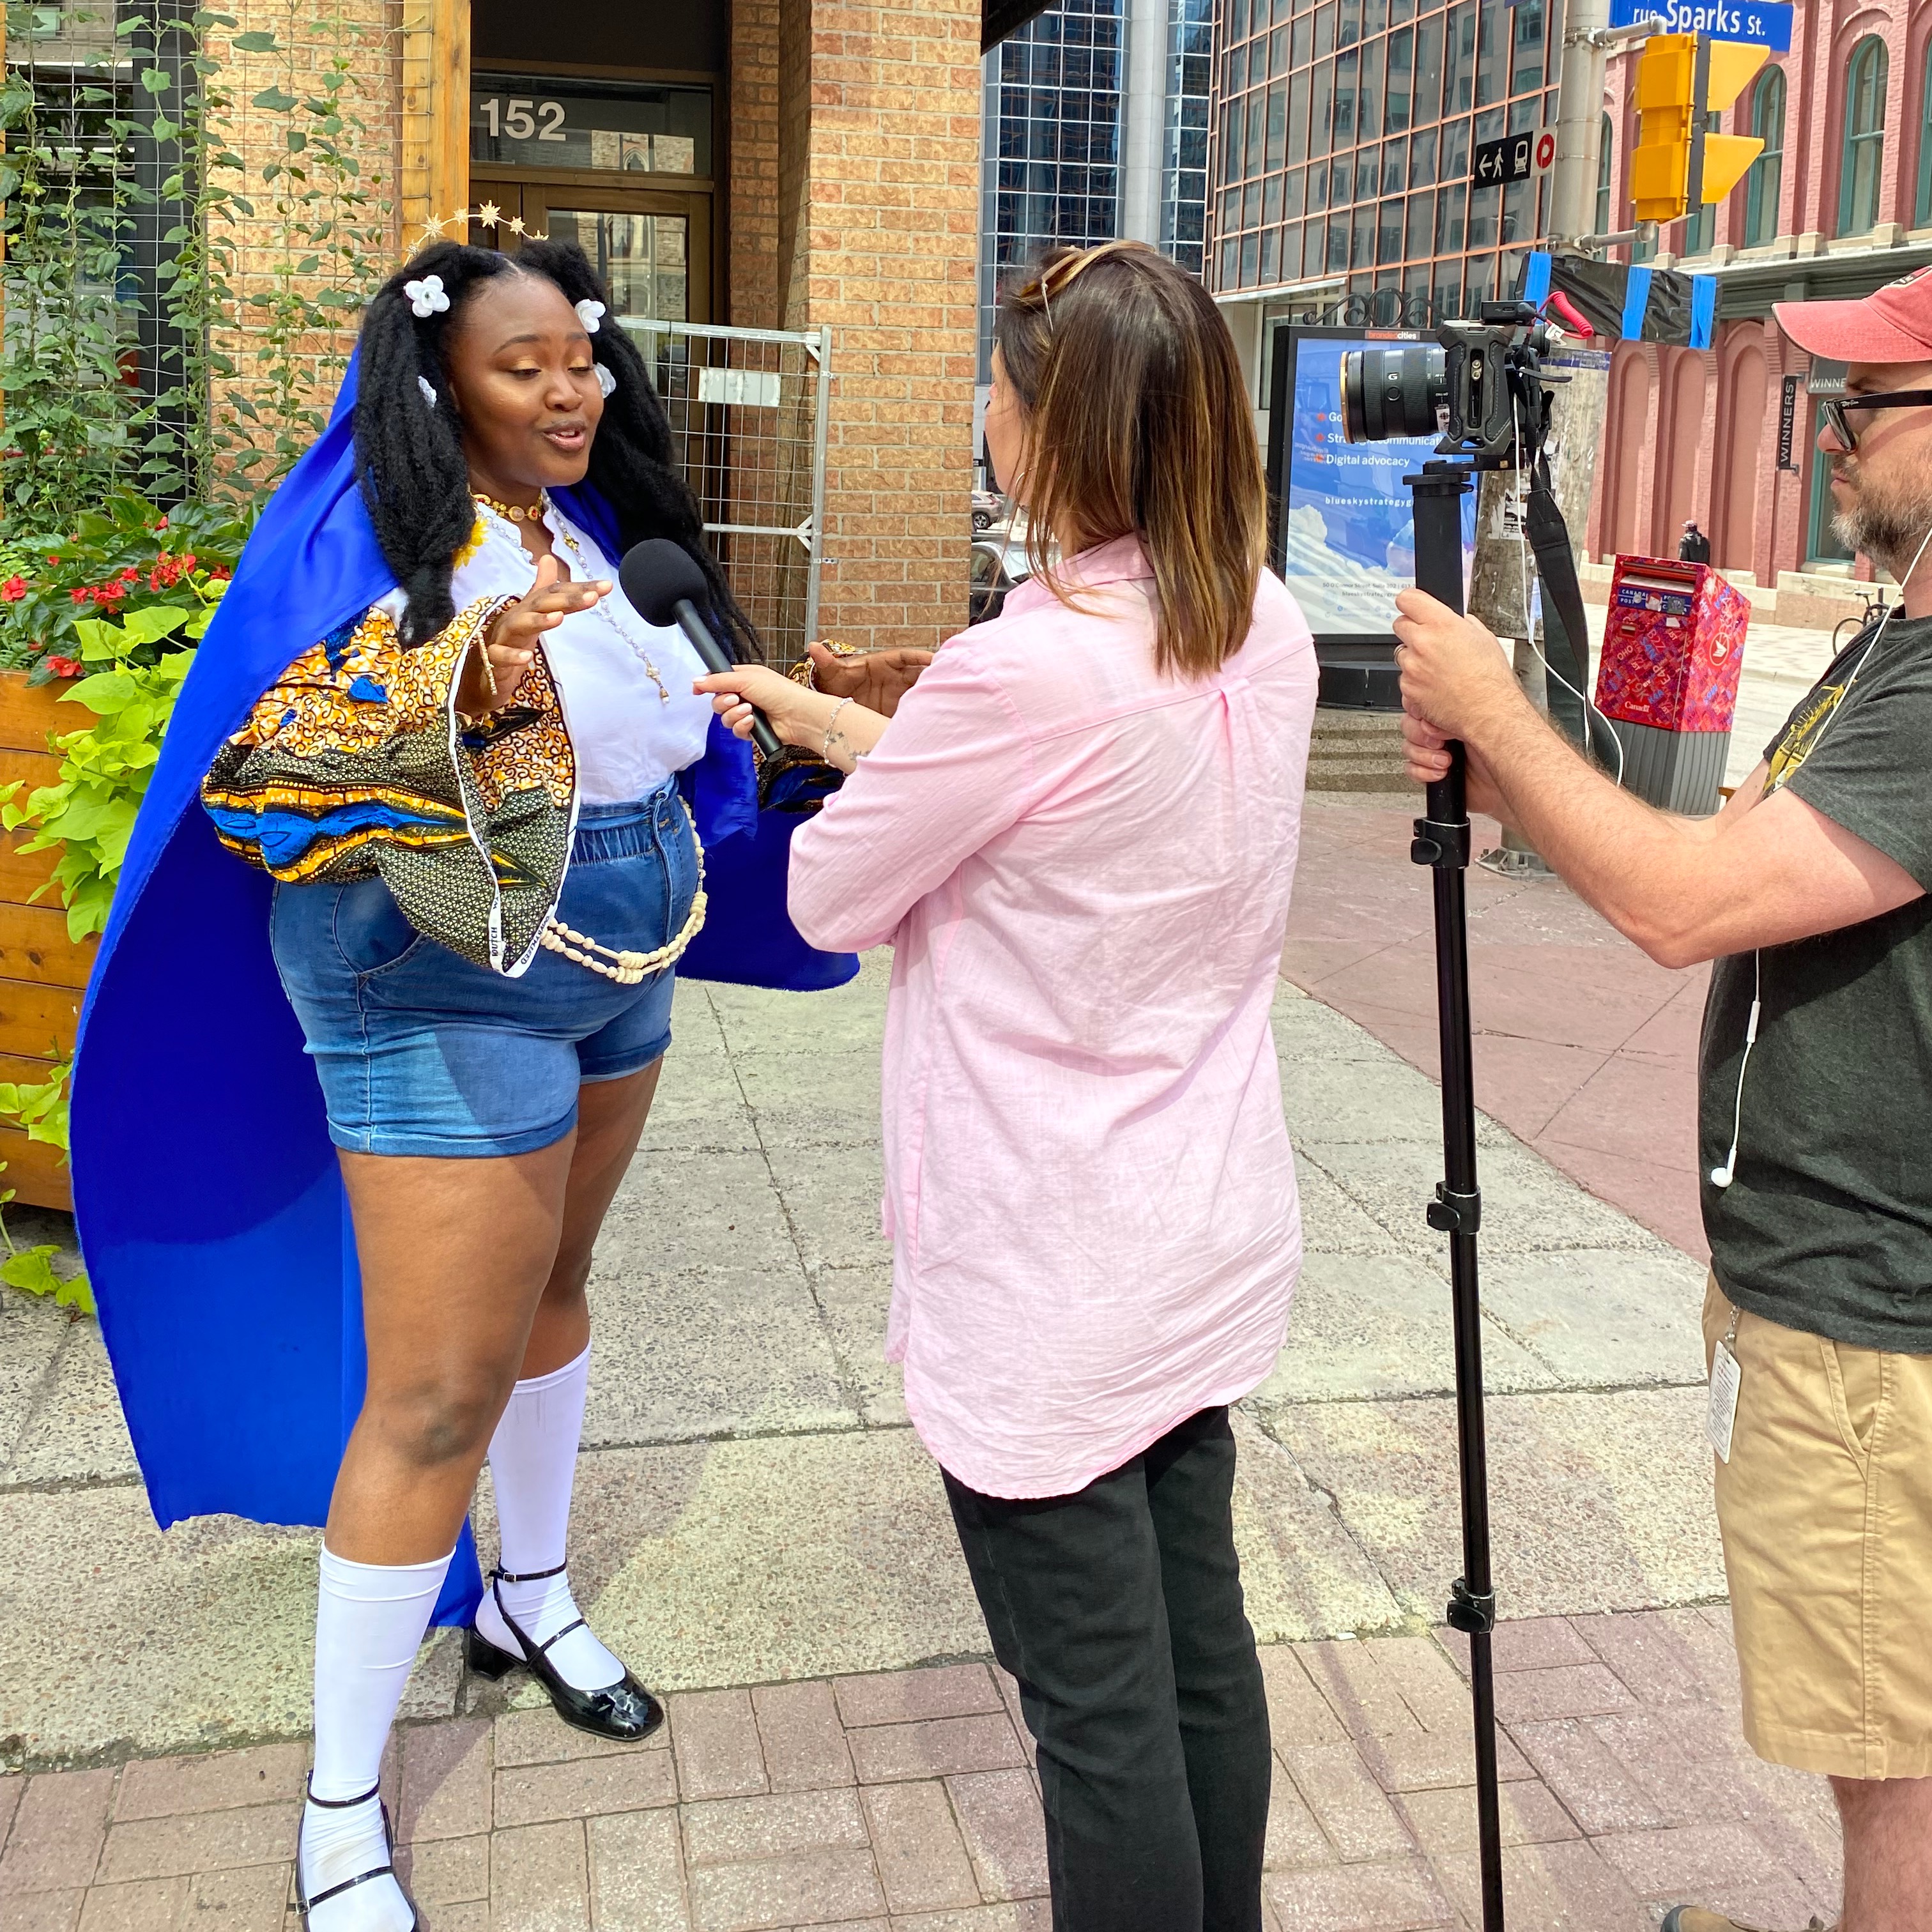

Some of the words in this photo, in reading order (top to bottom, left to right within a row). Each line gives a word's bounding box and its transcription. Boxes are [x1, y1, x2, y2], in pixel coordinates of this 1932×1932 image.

[1666, 0, 1740, 33] Sparks
[1747, 15, 1766, 36] St.
[480, 98, 566, 141] 152
[1811, 378, 1846, 388] WINNE
[1329, 411, 1342, 422] Go
[1781, 381, 1794, 463] WINNERS
[1326, 454, 1360, 466] Digital
[1361, 454, 1410, 468] advocacy
[1325, 496, 1412, 507] blueskystrategyg
